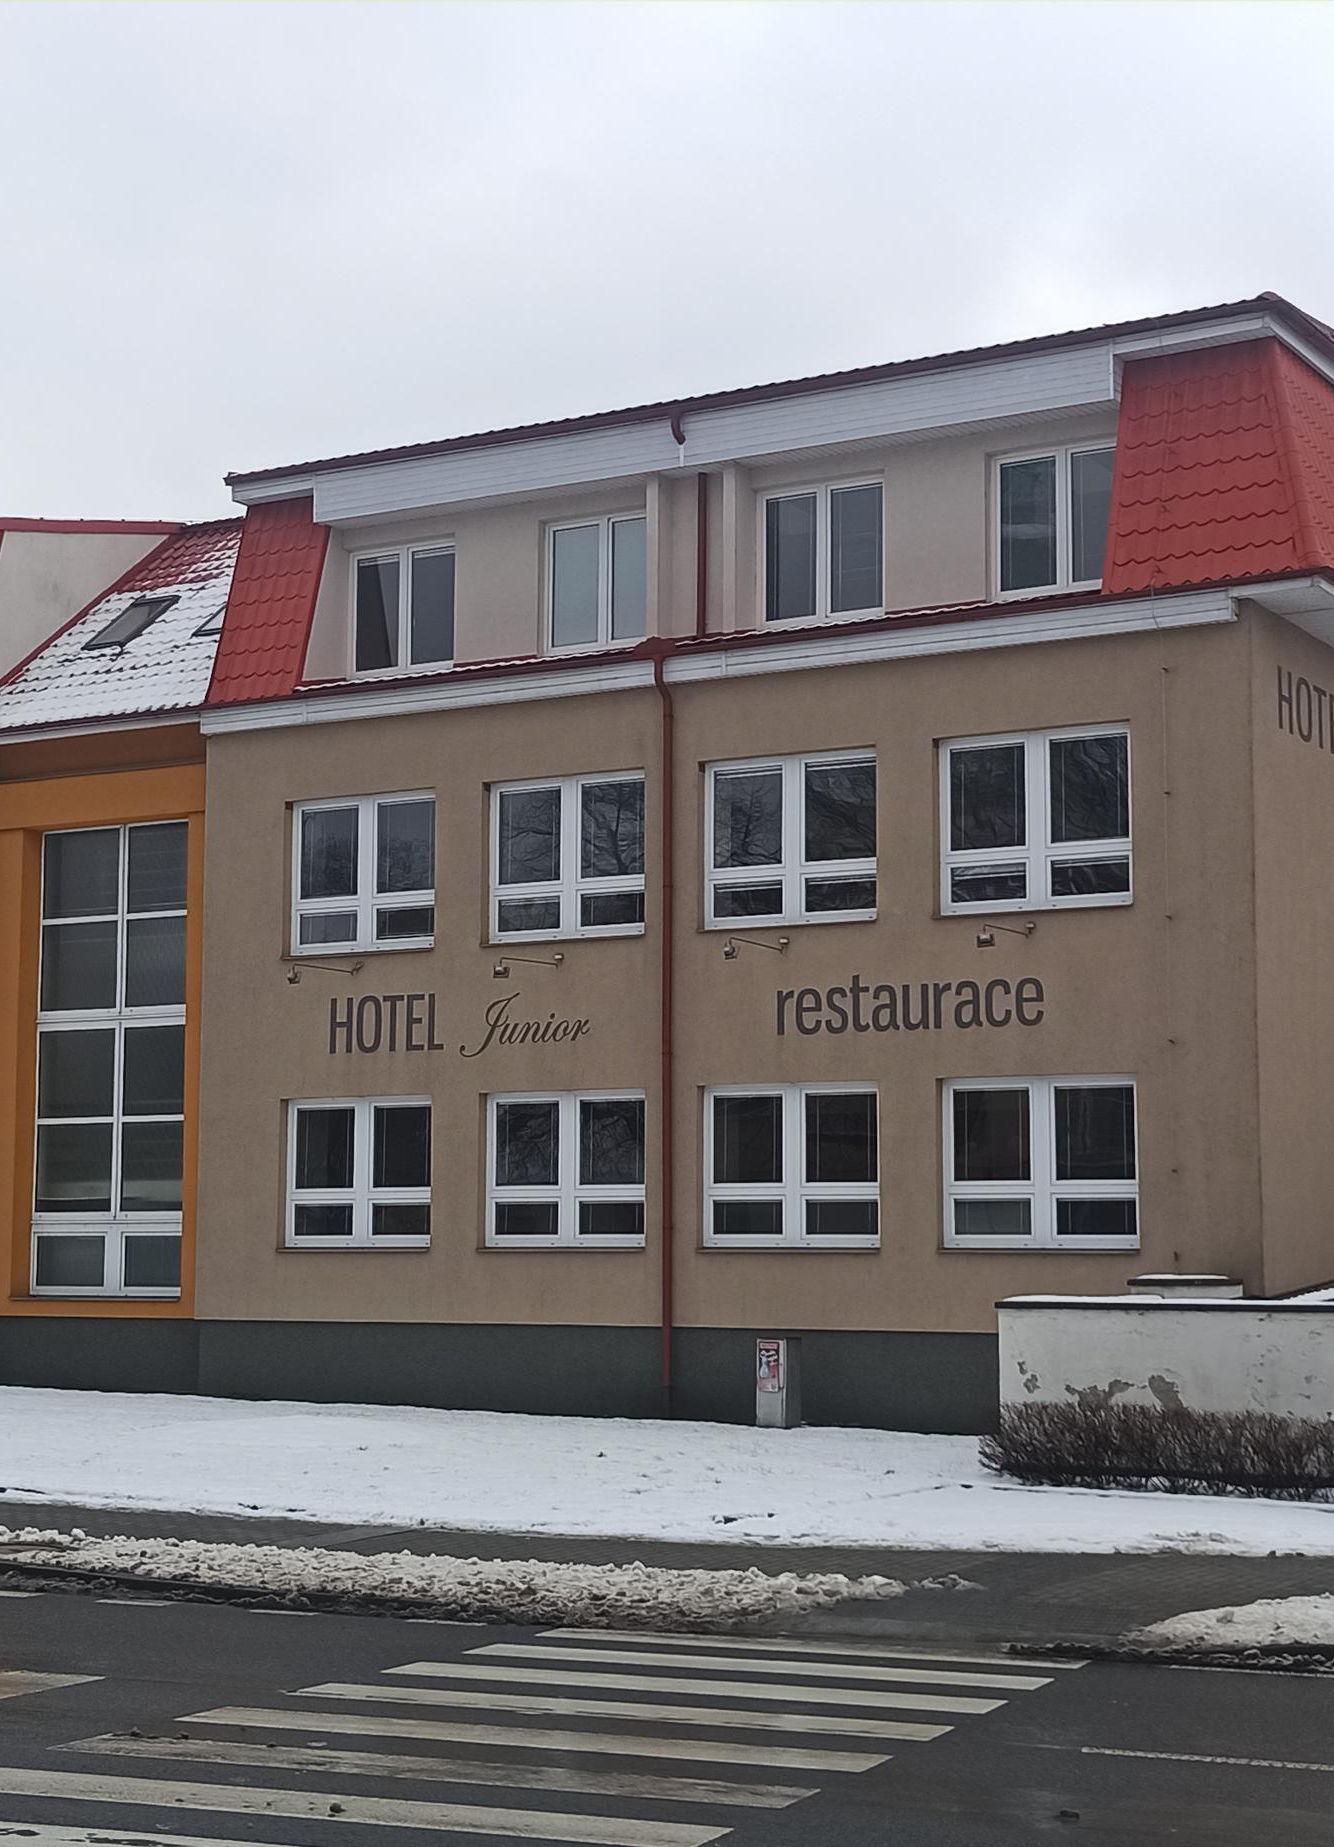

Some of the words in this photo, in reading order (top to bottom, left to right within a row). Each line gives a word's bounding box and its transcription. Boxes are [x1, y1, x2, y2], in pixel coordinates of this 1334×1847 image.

[329, 993, 444, 1054] HOTEL
[459, 992, 590, 1058] Junior
[776, 974, 1045, 1036] restaurace
